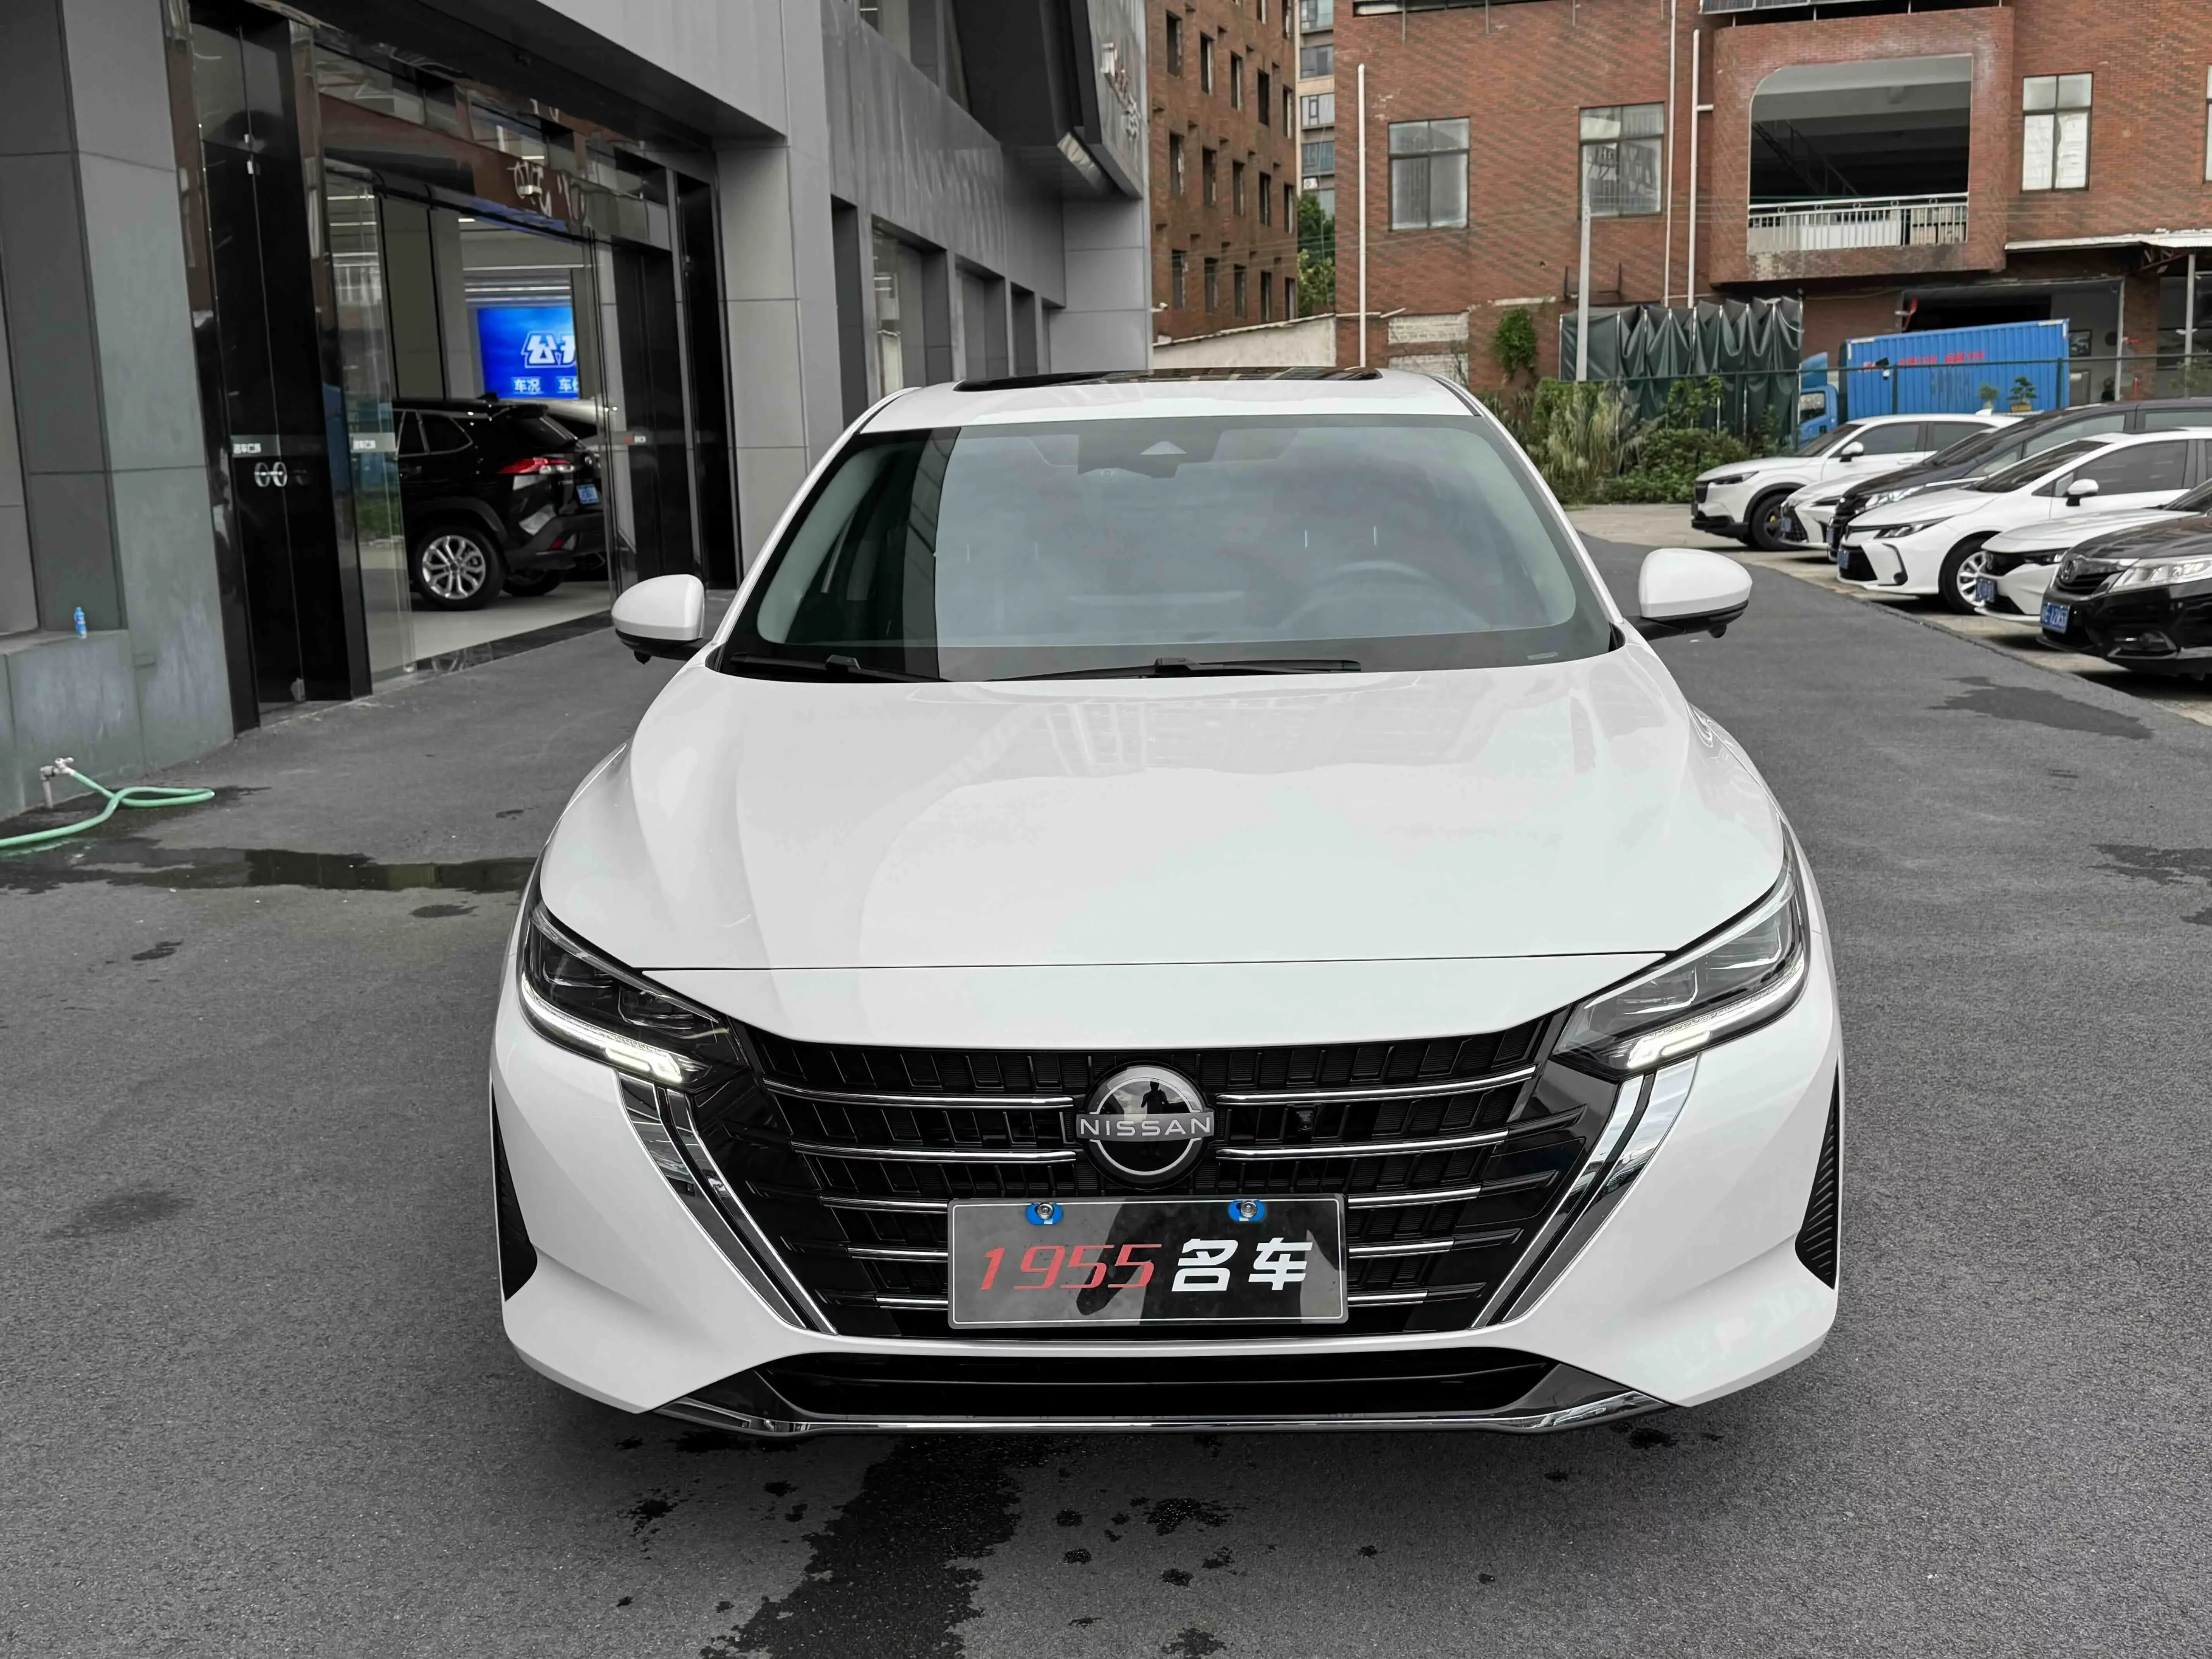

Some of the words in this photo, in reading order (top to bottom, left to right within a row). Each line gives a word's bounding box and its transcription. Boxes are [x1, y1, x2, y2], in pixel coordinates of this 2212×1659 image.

[514, 378, 540, 393] 车况
[1080, 1116, 1211, 1137] NISSAN
[981, 1244, 1161, 1290] 1955
[1171, 1237, 1312, 1292] 名车
